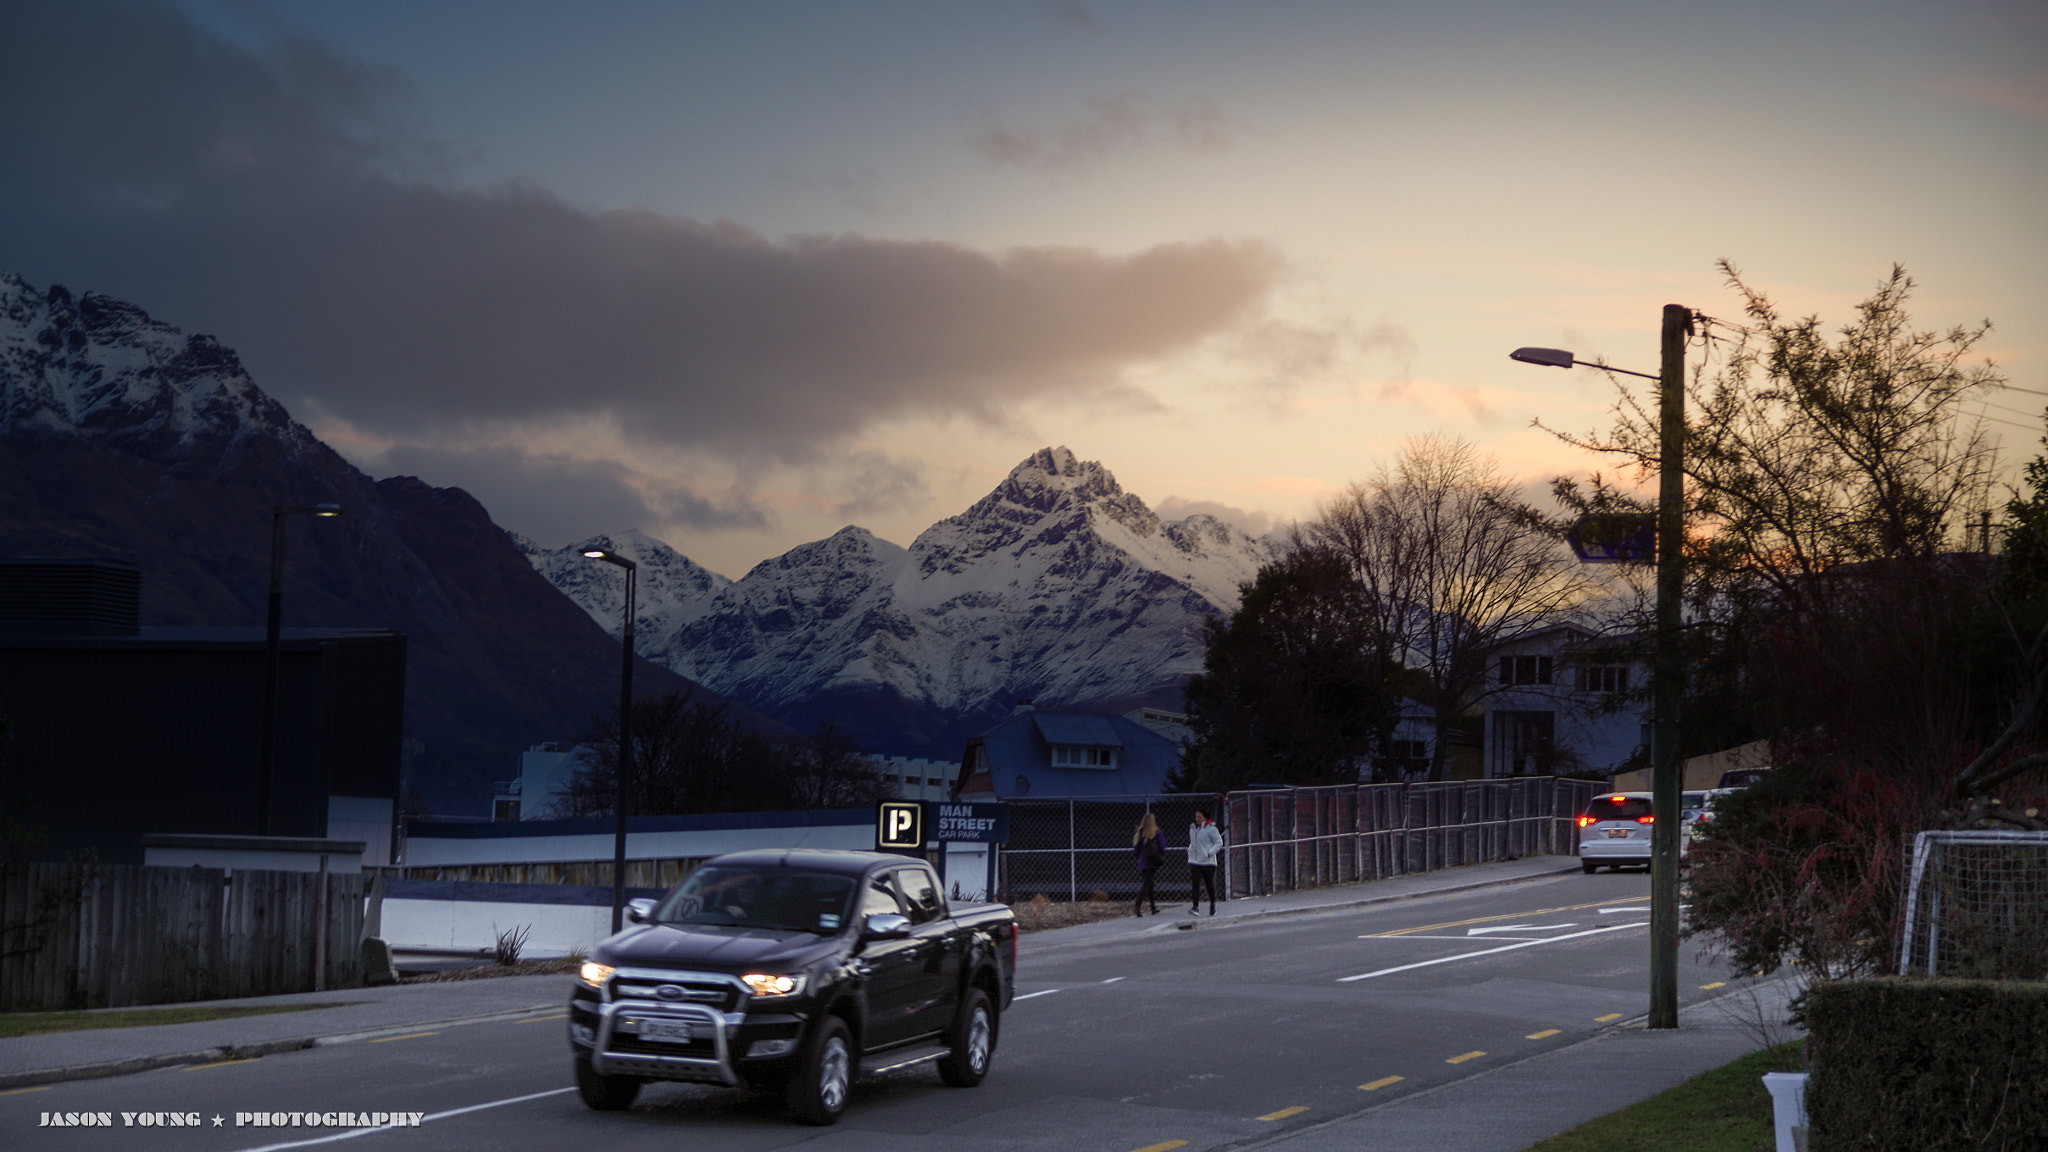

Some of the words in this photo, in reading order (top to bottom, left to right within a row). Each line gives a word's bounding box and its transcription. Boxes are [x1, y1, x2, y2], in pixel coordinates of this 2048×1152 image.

[939, 805, 972, 817] MAN
[889, 809, 912, 840] P
[938, 818, 996, 831] STREET
[938, 830, 957, 839] CAR
[957, 831, 980, 840] PARK
